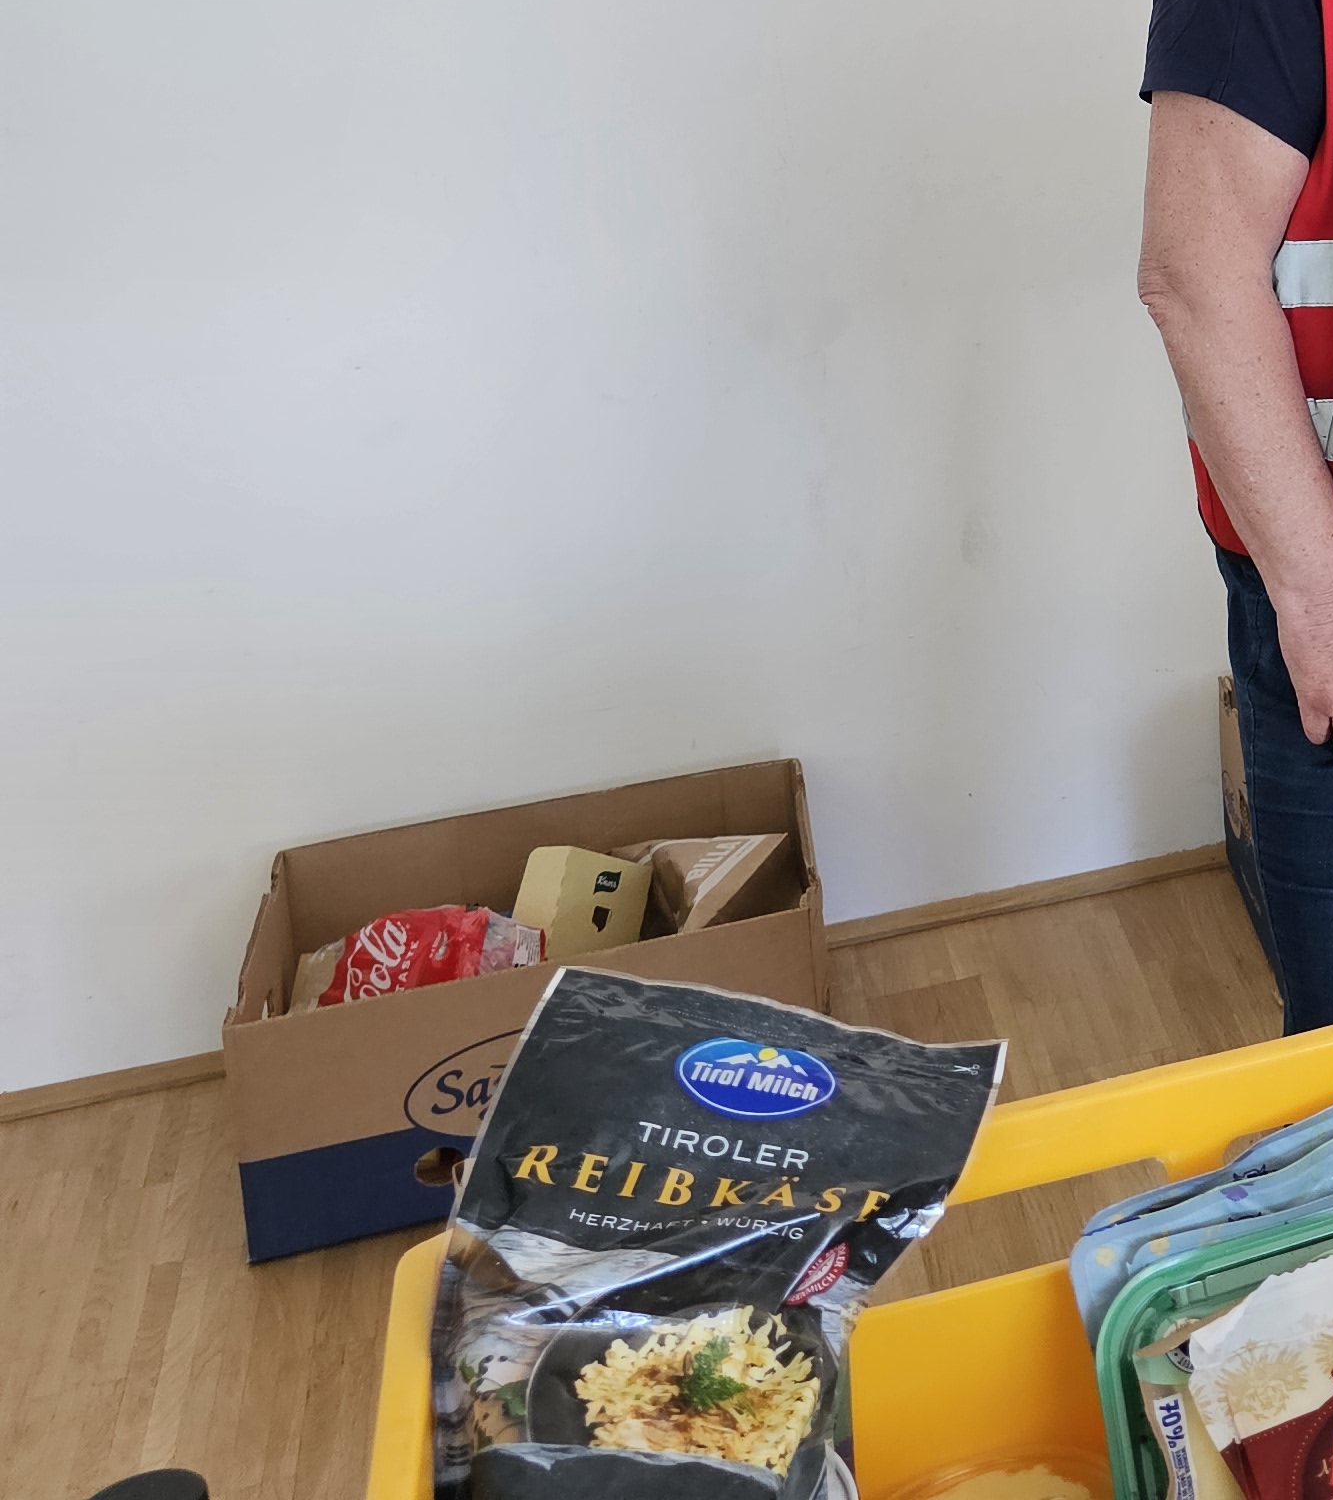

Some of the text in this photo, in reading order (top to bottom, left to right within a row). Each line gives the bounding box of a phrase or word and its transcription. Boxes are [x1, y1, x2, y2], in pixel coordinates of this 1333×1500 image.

[691, 1062, 819, 1101] Tirol Milch
[638, 1121, 810, 1170] TIROLER
